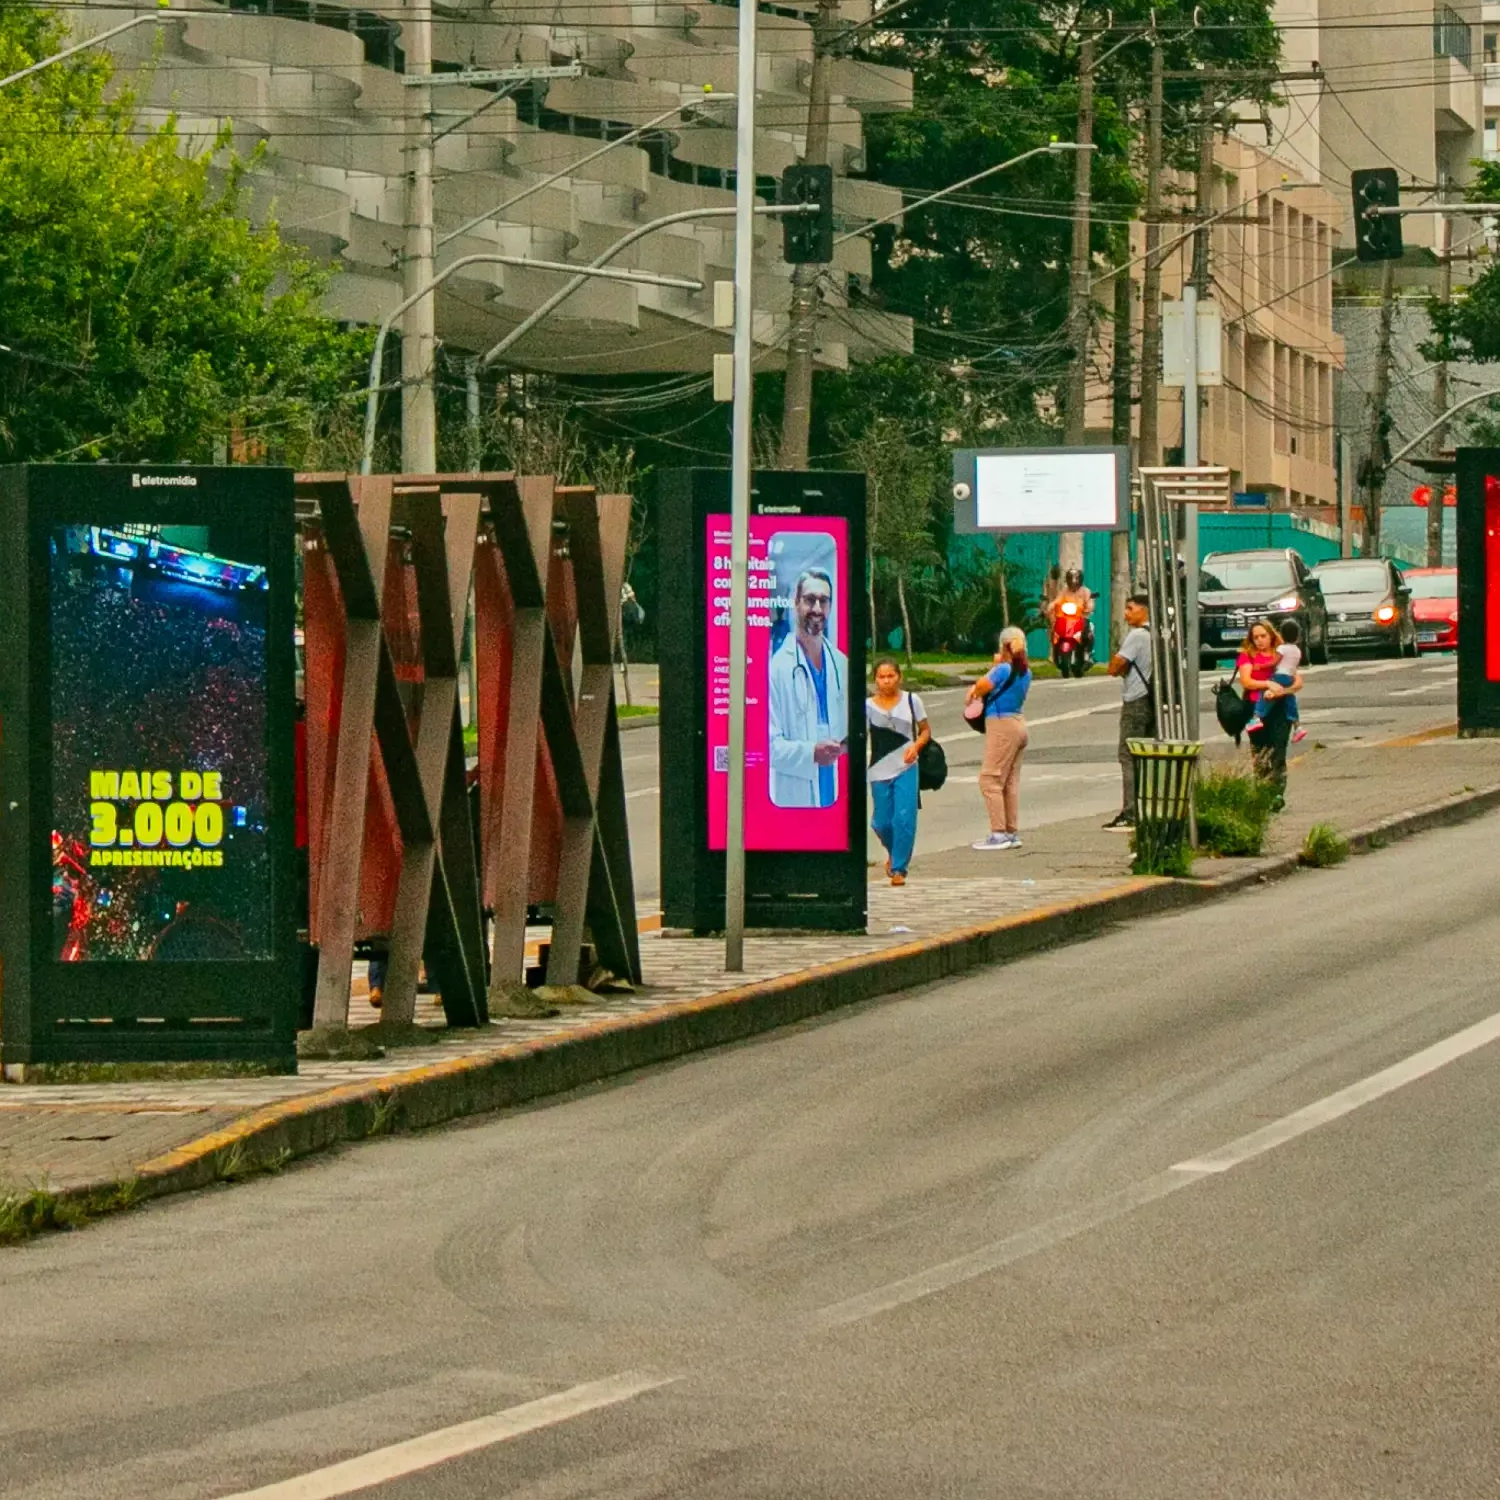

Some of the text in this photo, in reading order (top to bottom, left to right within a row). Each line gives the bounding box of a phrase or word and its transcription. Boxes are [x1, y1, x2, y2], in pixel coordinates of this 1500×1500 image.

[759, 575, 777, 590] mil
[90, 770, 222, 800] MAIS DE
[90, 802, 223, 847] 3.000
[90, 847, 223, 870] APRESENTAÇÕES
